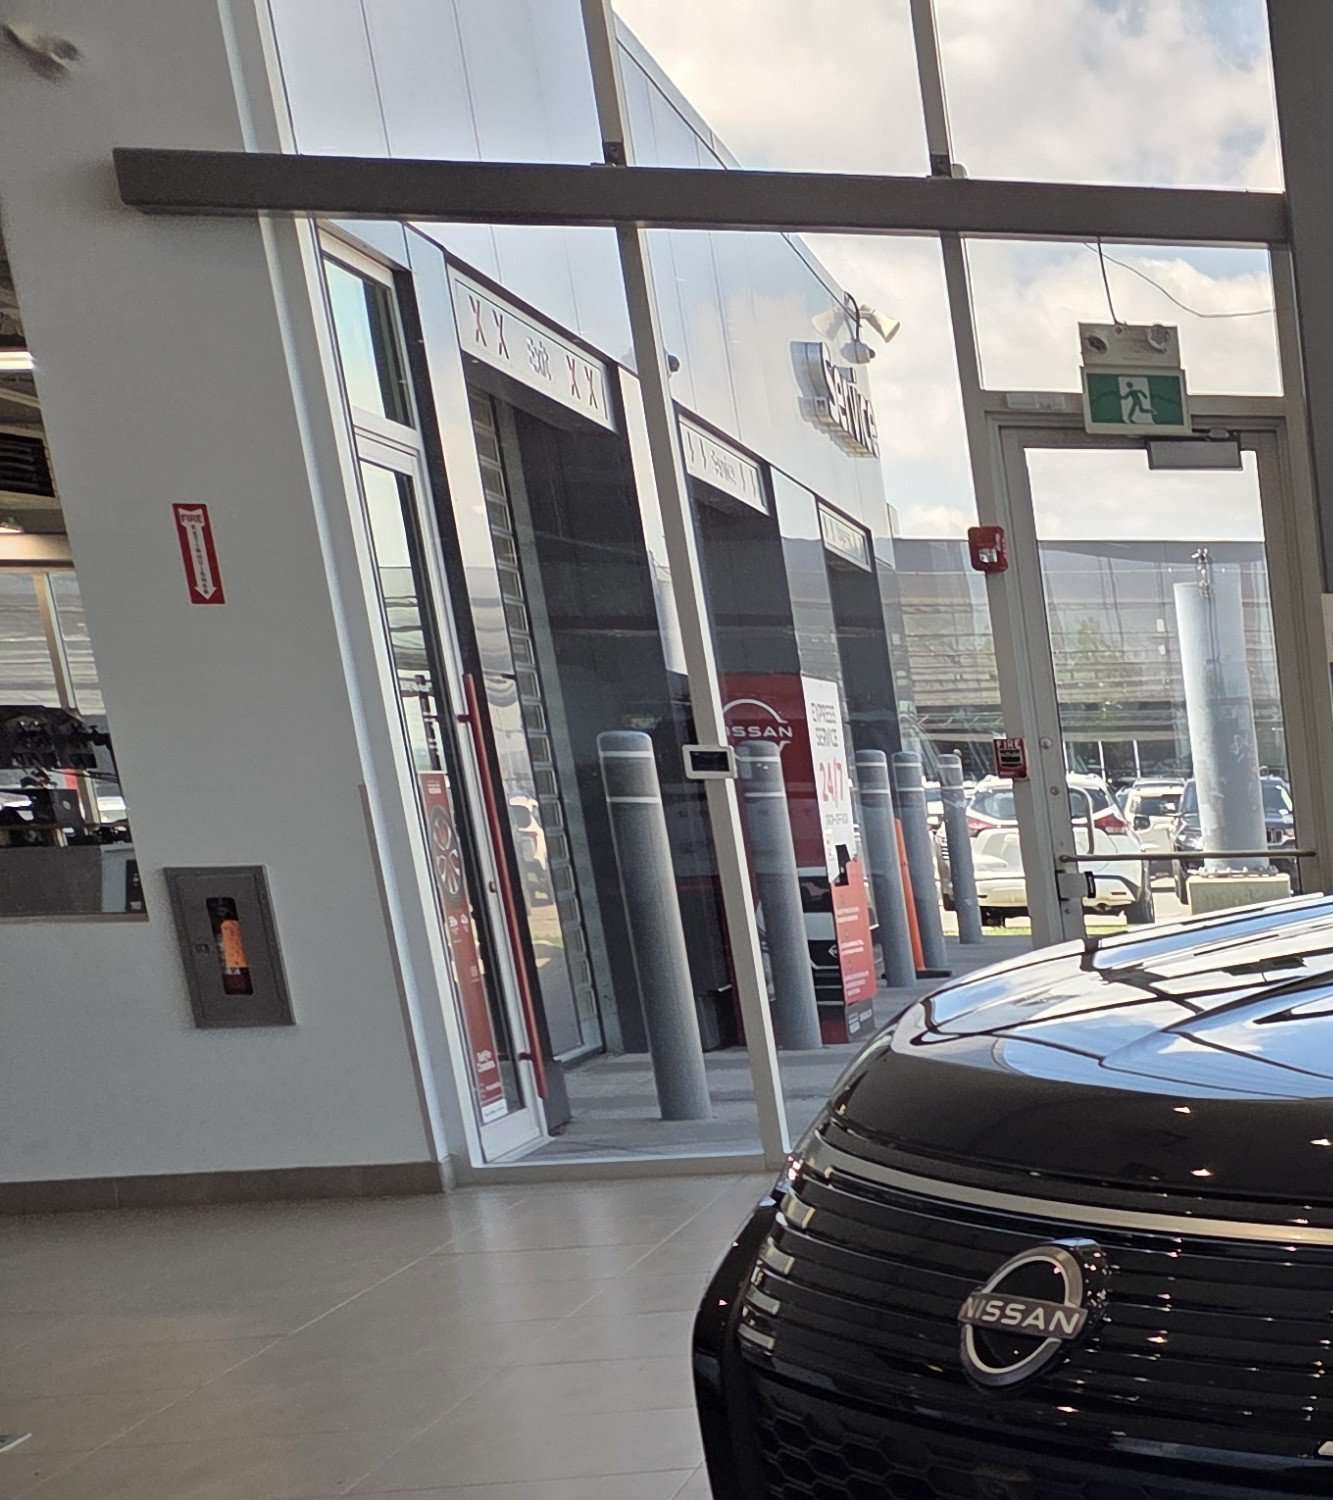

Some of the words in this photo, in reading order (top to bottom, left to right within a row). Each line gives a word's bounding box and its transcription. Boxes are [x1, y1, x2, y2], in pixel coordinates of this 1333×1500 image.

[181, 514, 202, 524] FIRE
[726, 725, 793, 738] ISSAN
[818, 756, 845, 808] 24/7
[961, 1297, 1079, 1334] NISSAN
